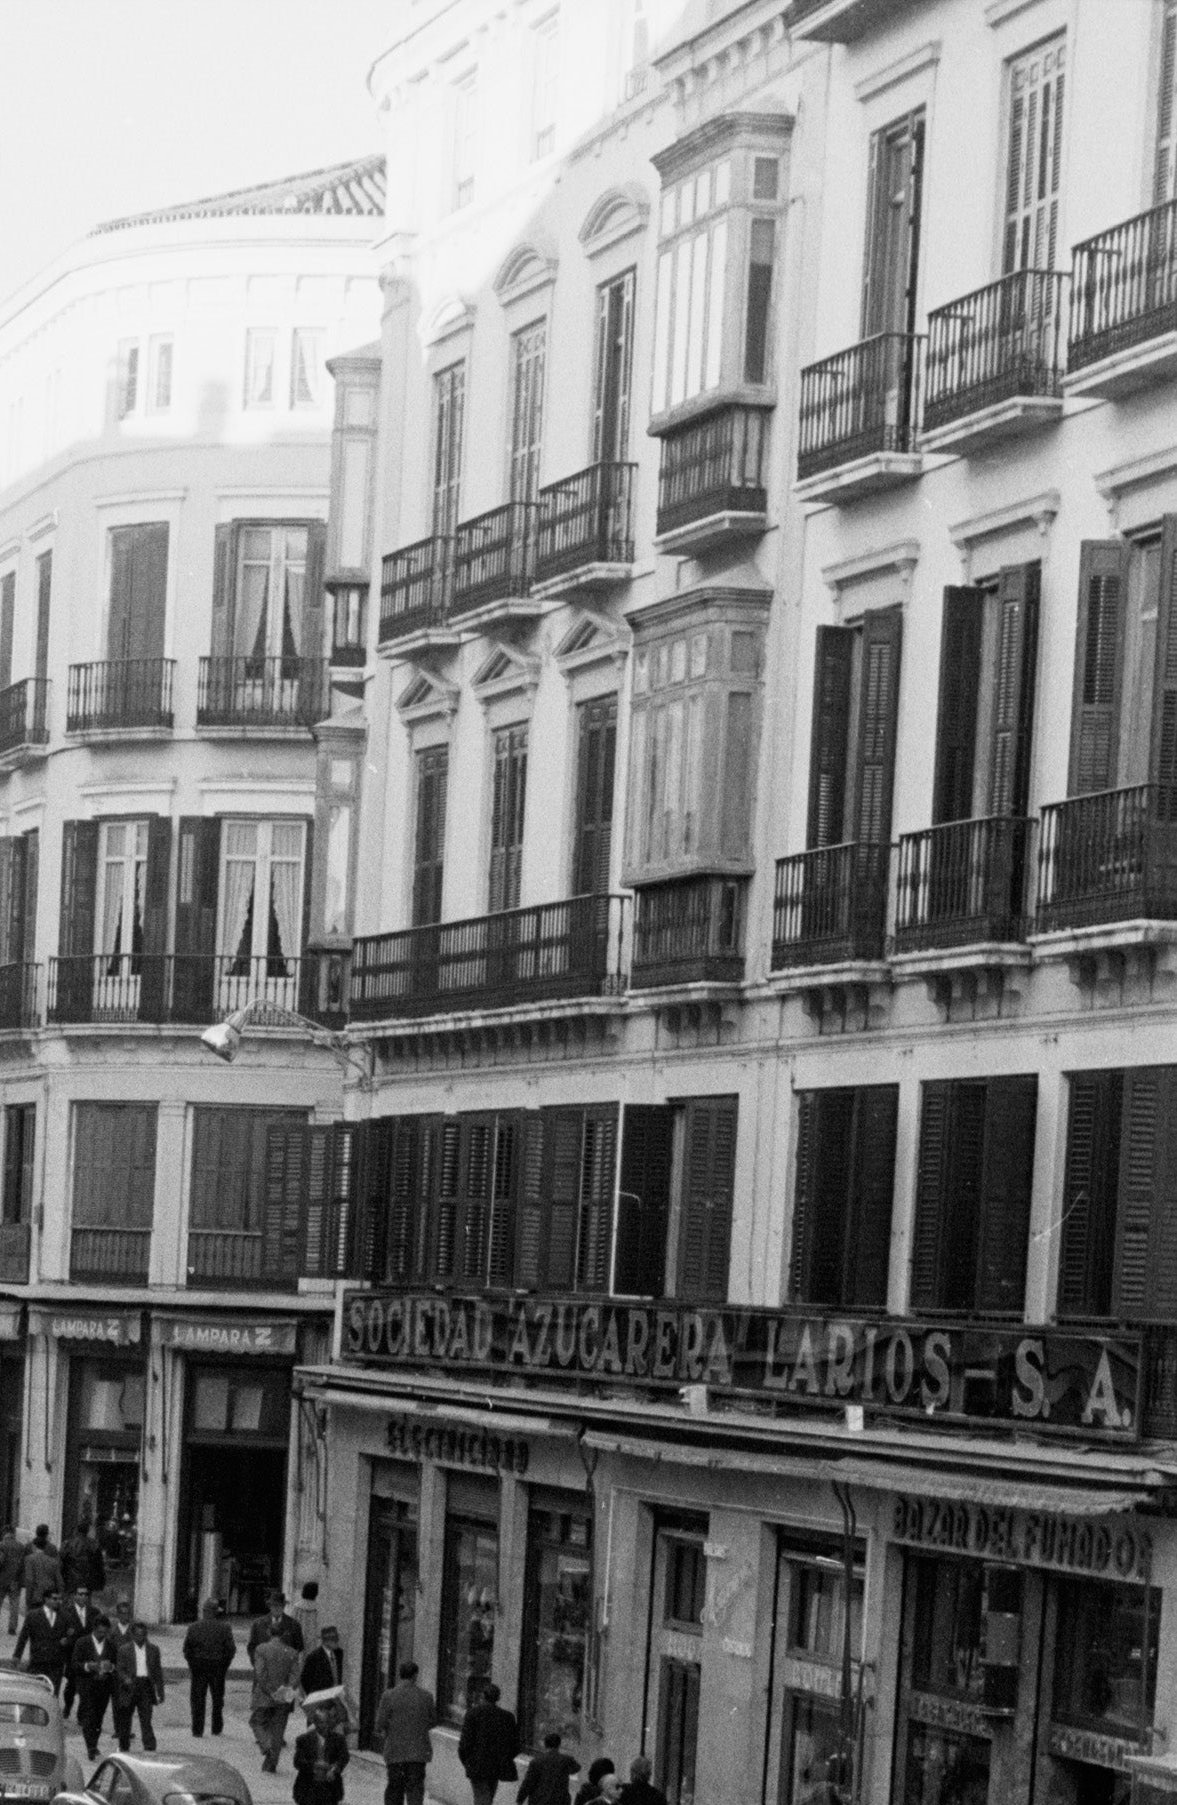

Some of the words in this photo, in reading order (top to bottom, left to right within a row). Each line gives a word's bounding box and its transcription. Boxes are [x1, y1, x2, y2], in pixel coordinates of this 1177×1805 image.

[51, 1318, 104, 1339] LAMPARA
[106, 1318, 120, 1337] Z
[173, 1325, 252, 1346] LAMPARA
[254, 1326, 273, 1345] Z
[348, 1297, 492, 1361] SOCIEDAD
[508, 1299, 733, 1385] AZUCARERA
[1080, 1345, 1132, 1427] A.
[892, 1496, 970, 1550] BAZAR
[972, 1503, 1018, 1560] DEL
[1022, 1511, 1155, 1579] FUMADOR
